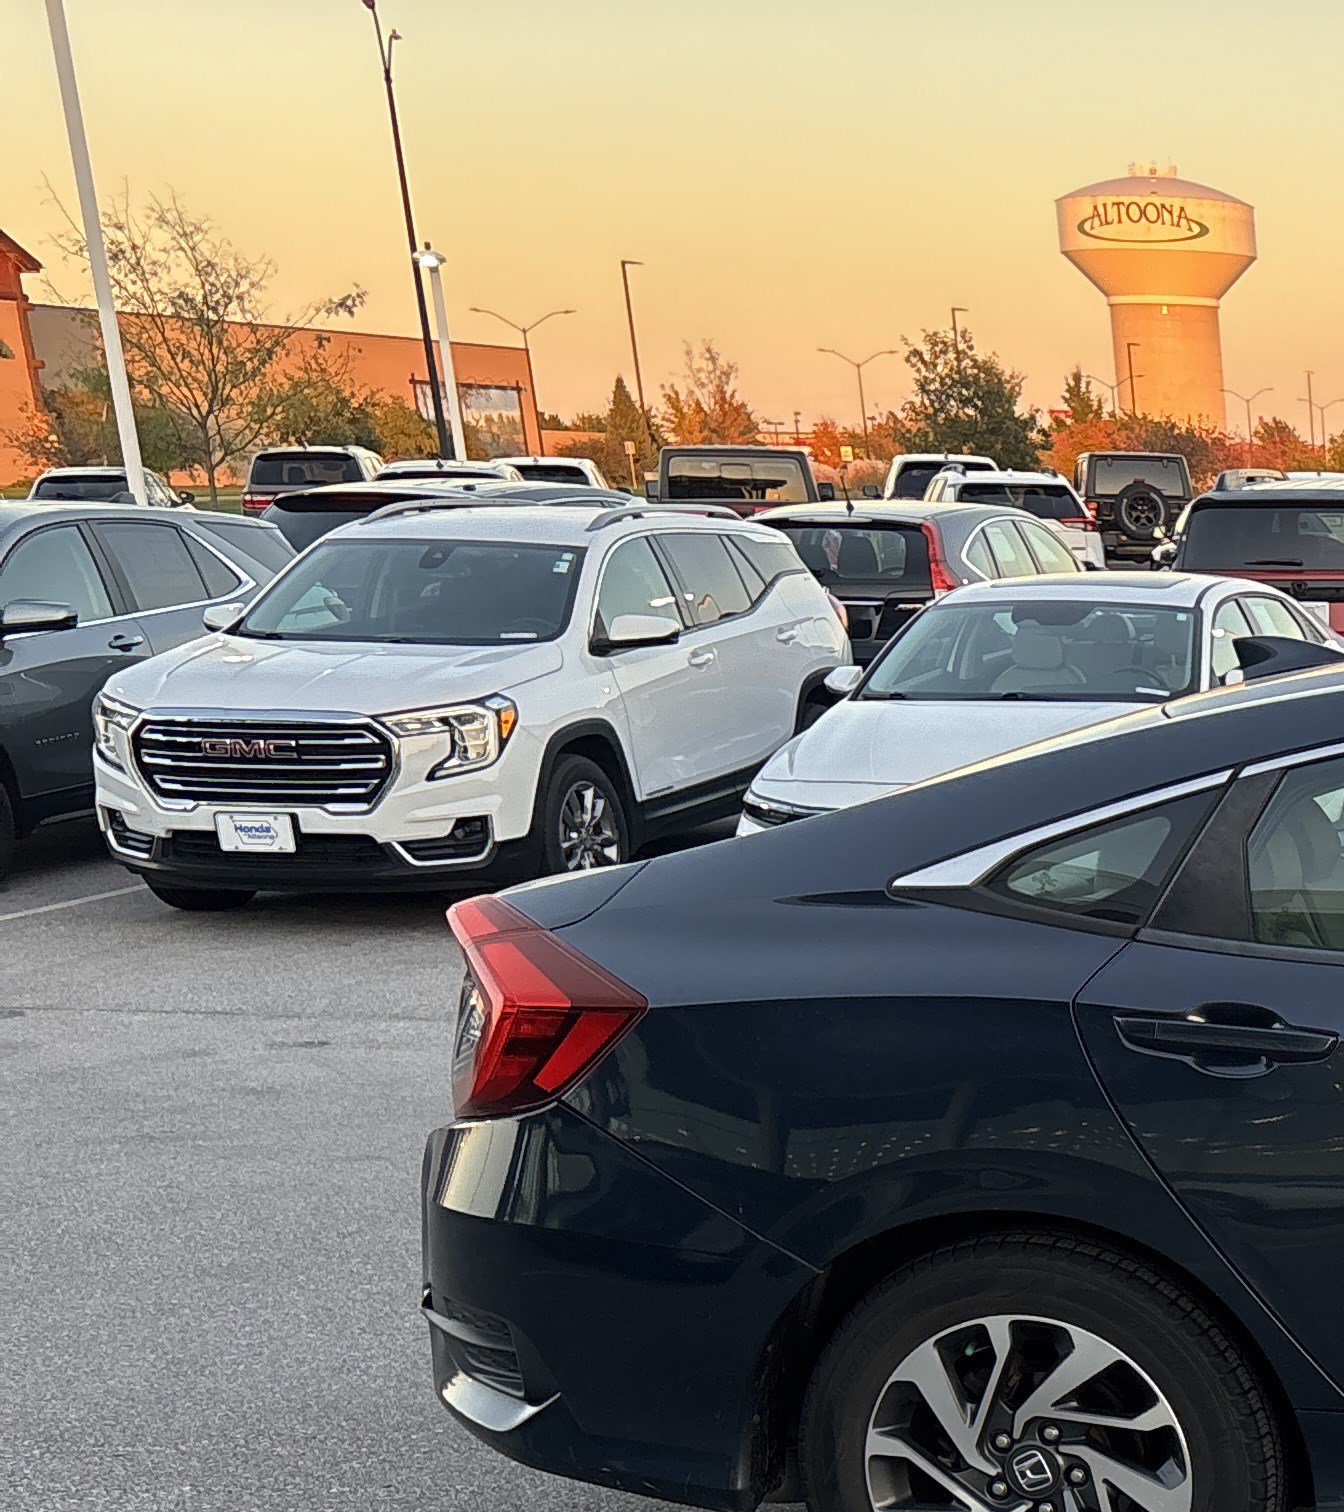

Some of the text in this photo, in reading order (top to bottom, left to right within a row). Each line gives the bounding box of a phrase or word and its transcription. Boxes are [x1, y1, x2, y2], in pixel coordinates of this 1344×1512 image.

[1090, 201, 1194, 233] ALTOONA
[201, 738, 298, 758] GMC
[234, 823, 271, 833] Honda
